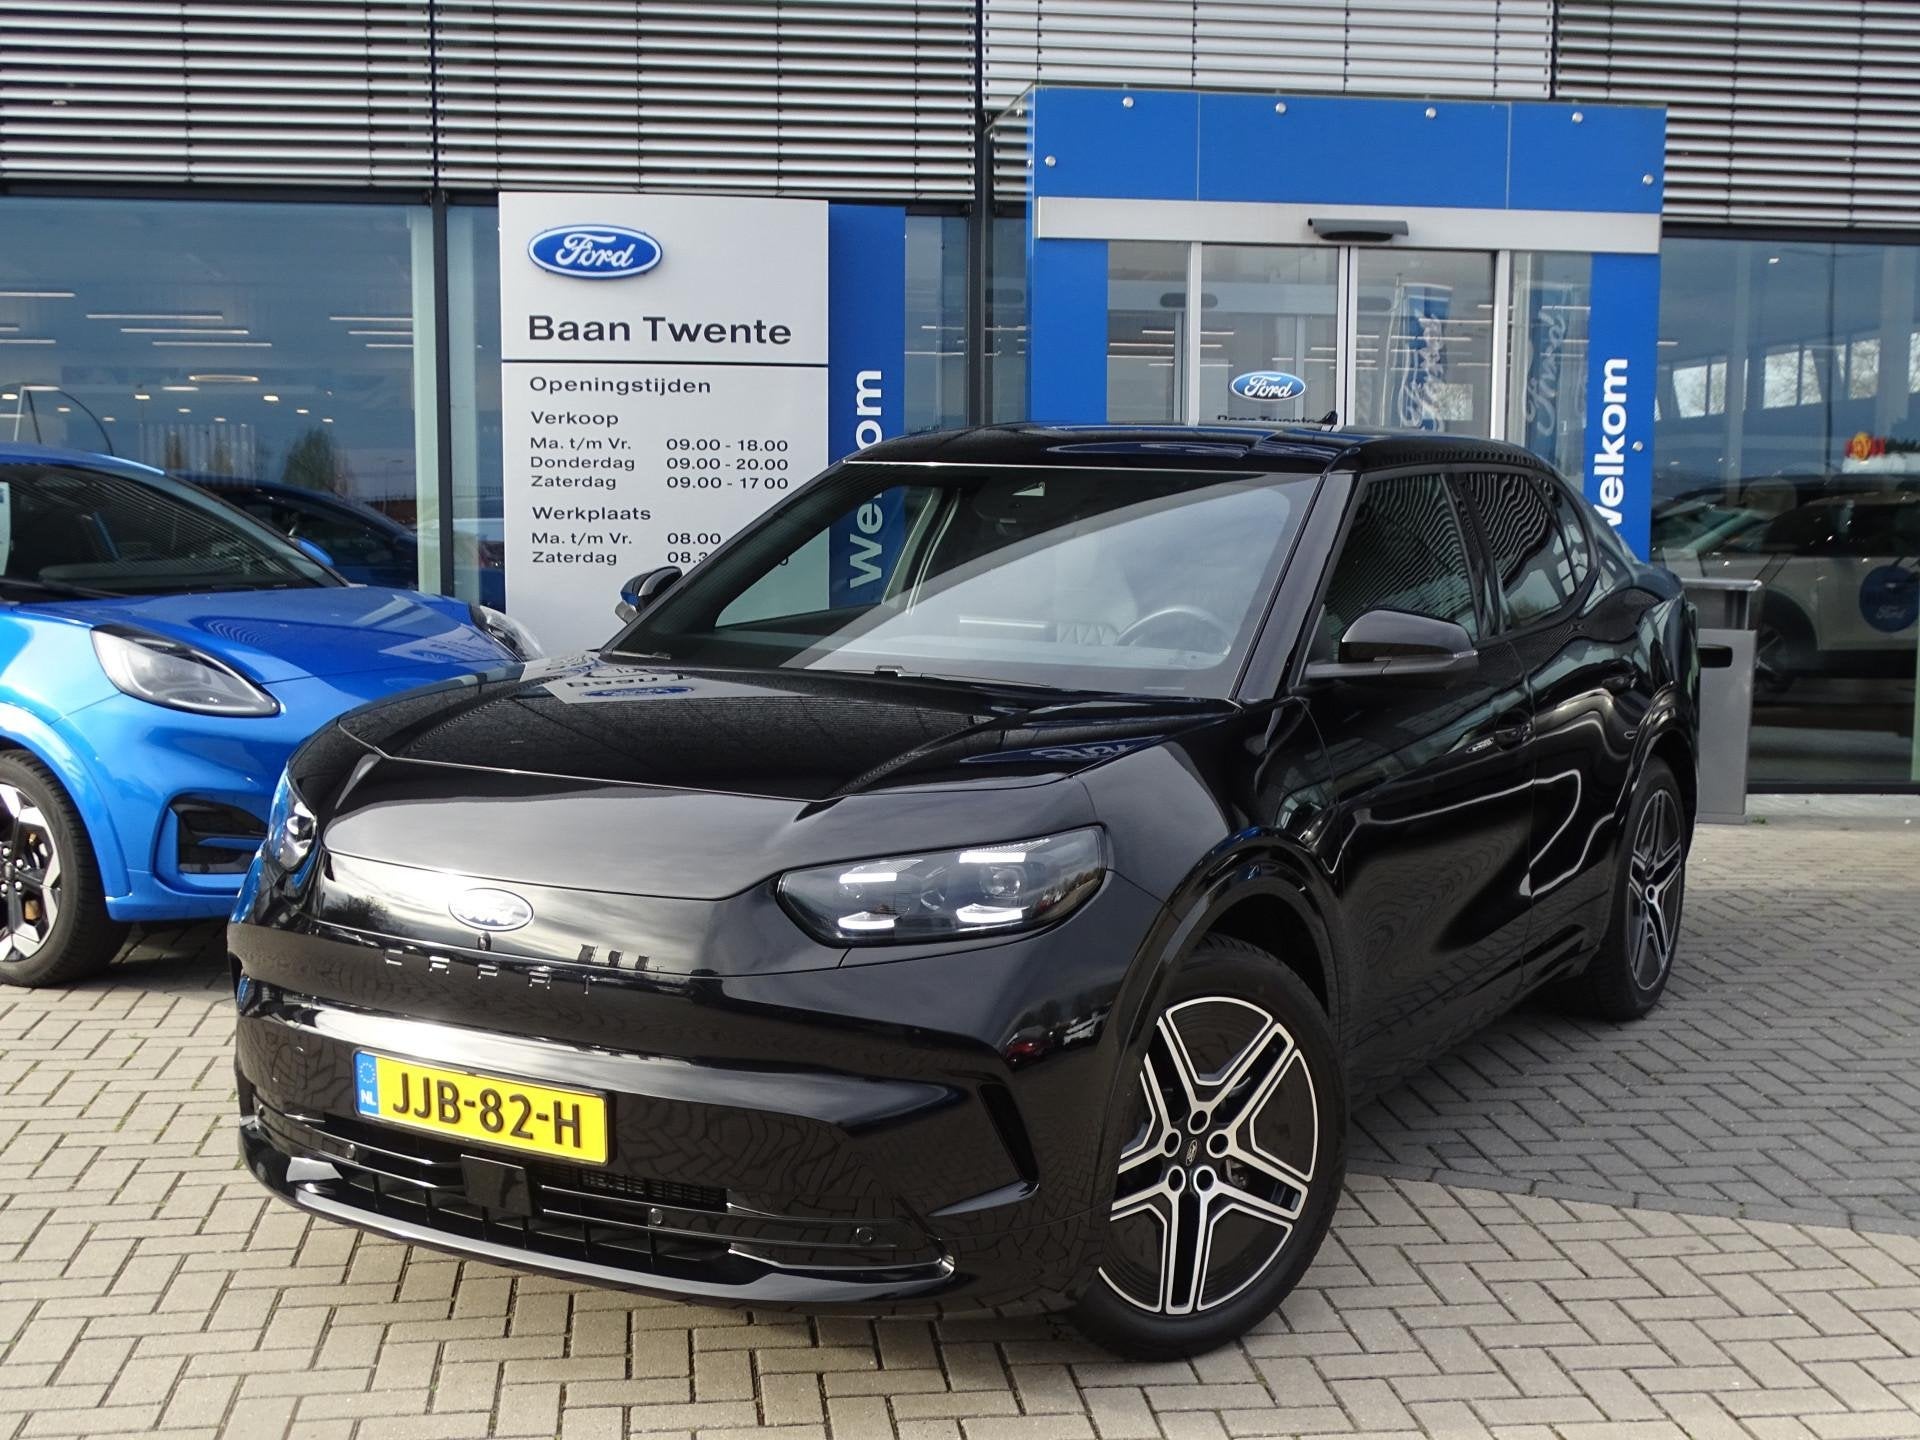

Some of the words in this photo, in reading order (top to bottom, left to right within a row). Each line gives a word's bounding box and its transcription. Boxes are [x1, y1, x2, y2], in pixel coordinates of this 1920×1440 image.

[554, 232, 636, 268] Ford
[528, 314, 631, 342] Baan
[642, 316, 793, 345] Twente
[529, 376, 712, 396] Openingstijden
[1243, 375, 1293, 398] Ford
[530, 411, 619, 428] Verkoop
[530, 437, 565, 450] Ma.
[569, 437, 603, 451] t/m
[608, 437, 632, 450] Vr.
[665, 438, 722, 451] 09.00
[737, 439, 789, 452] 18.00
[530, 456, 636, 472] Donderdag
[665, 457, 722, 470] 09.00
[735, 458, 789, 471] 20.00
[530, 475, 617, 491] Zaterdag
[665, 476, 722, 489] 09.00
[850, 370, 883, 589] Weom
[531, 506, 652, 523] Werkplaats
[531, 532, 566, 546] Ma.
[570, 532, 604, 547] t/m
[608, 532, 633, 546] Vr.
[666, 532, 722, 545] 08.00
[531, 551, 618, 567] Zaterdag
[666, 551, 708, 564] 08.3
[360, 1088, 378, 1107] NL
[392, 1072, 582, 1149] JJB-82-H
